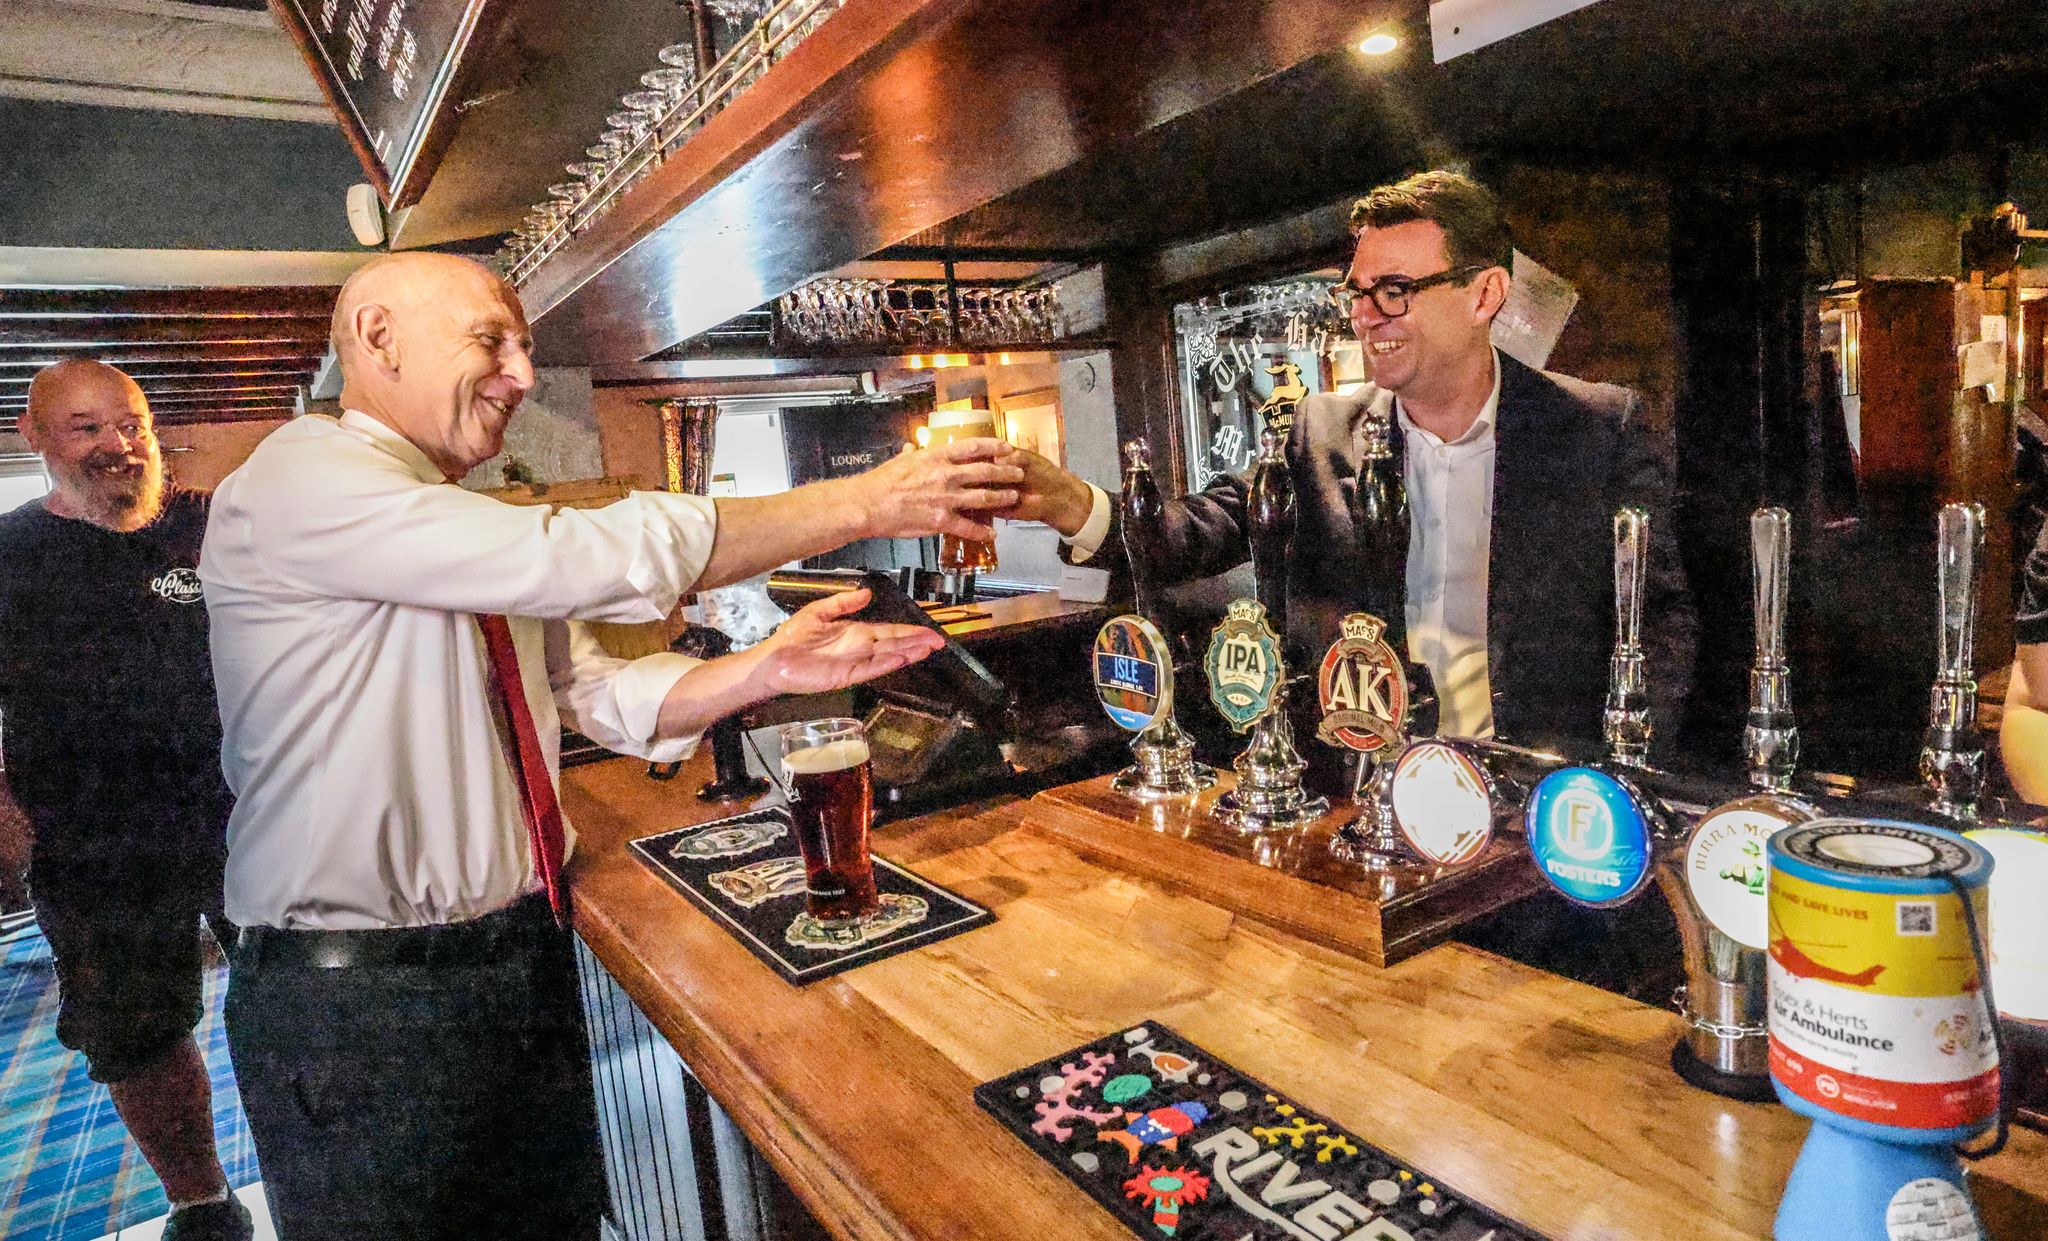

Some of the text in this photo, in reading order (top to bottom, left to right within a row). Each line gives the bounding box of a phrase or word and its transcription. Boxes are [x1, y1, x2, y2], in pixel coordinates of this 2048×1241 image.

[1209, 332, 1264, 393] The
[831, 453, 874, 466] LOUNGE
[1114, 657, 1138, 683] ISLE
[1225, 643, 1261, 674] IPA
[1326, 659, 1394, 722] AK
[1695, 825, 1737, 871] BIRRA
[1833, 905, 1869, 920] LIVES
[1791, 1010, 1894, 1051] Ambulance
[1803, 998, 1815, 1015] &
[1819, 1004, 1869, 1031] Herts
